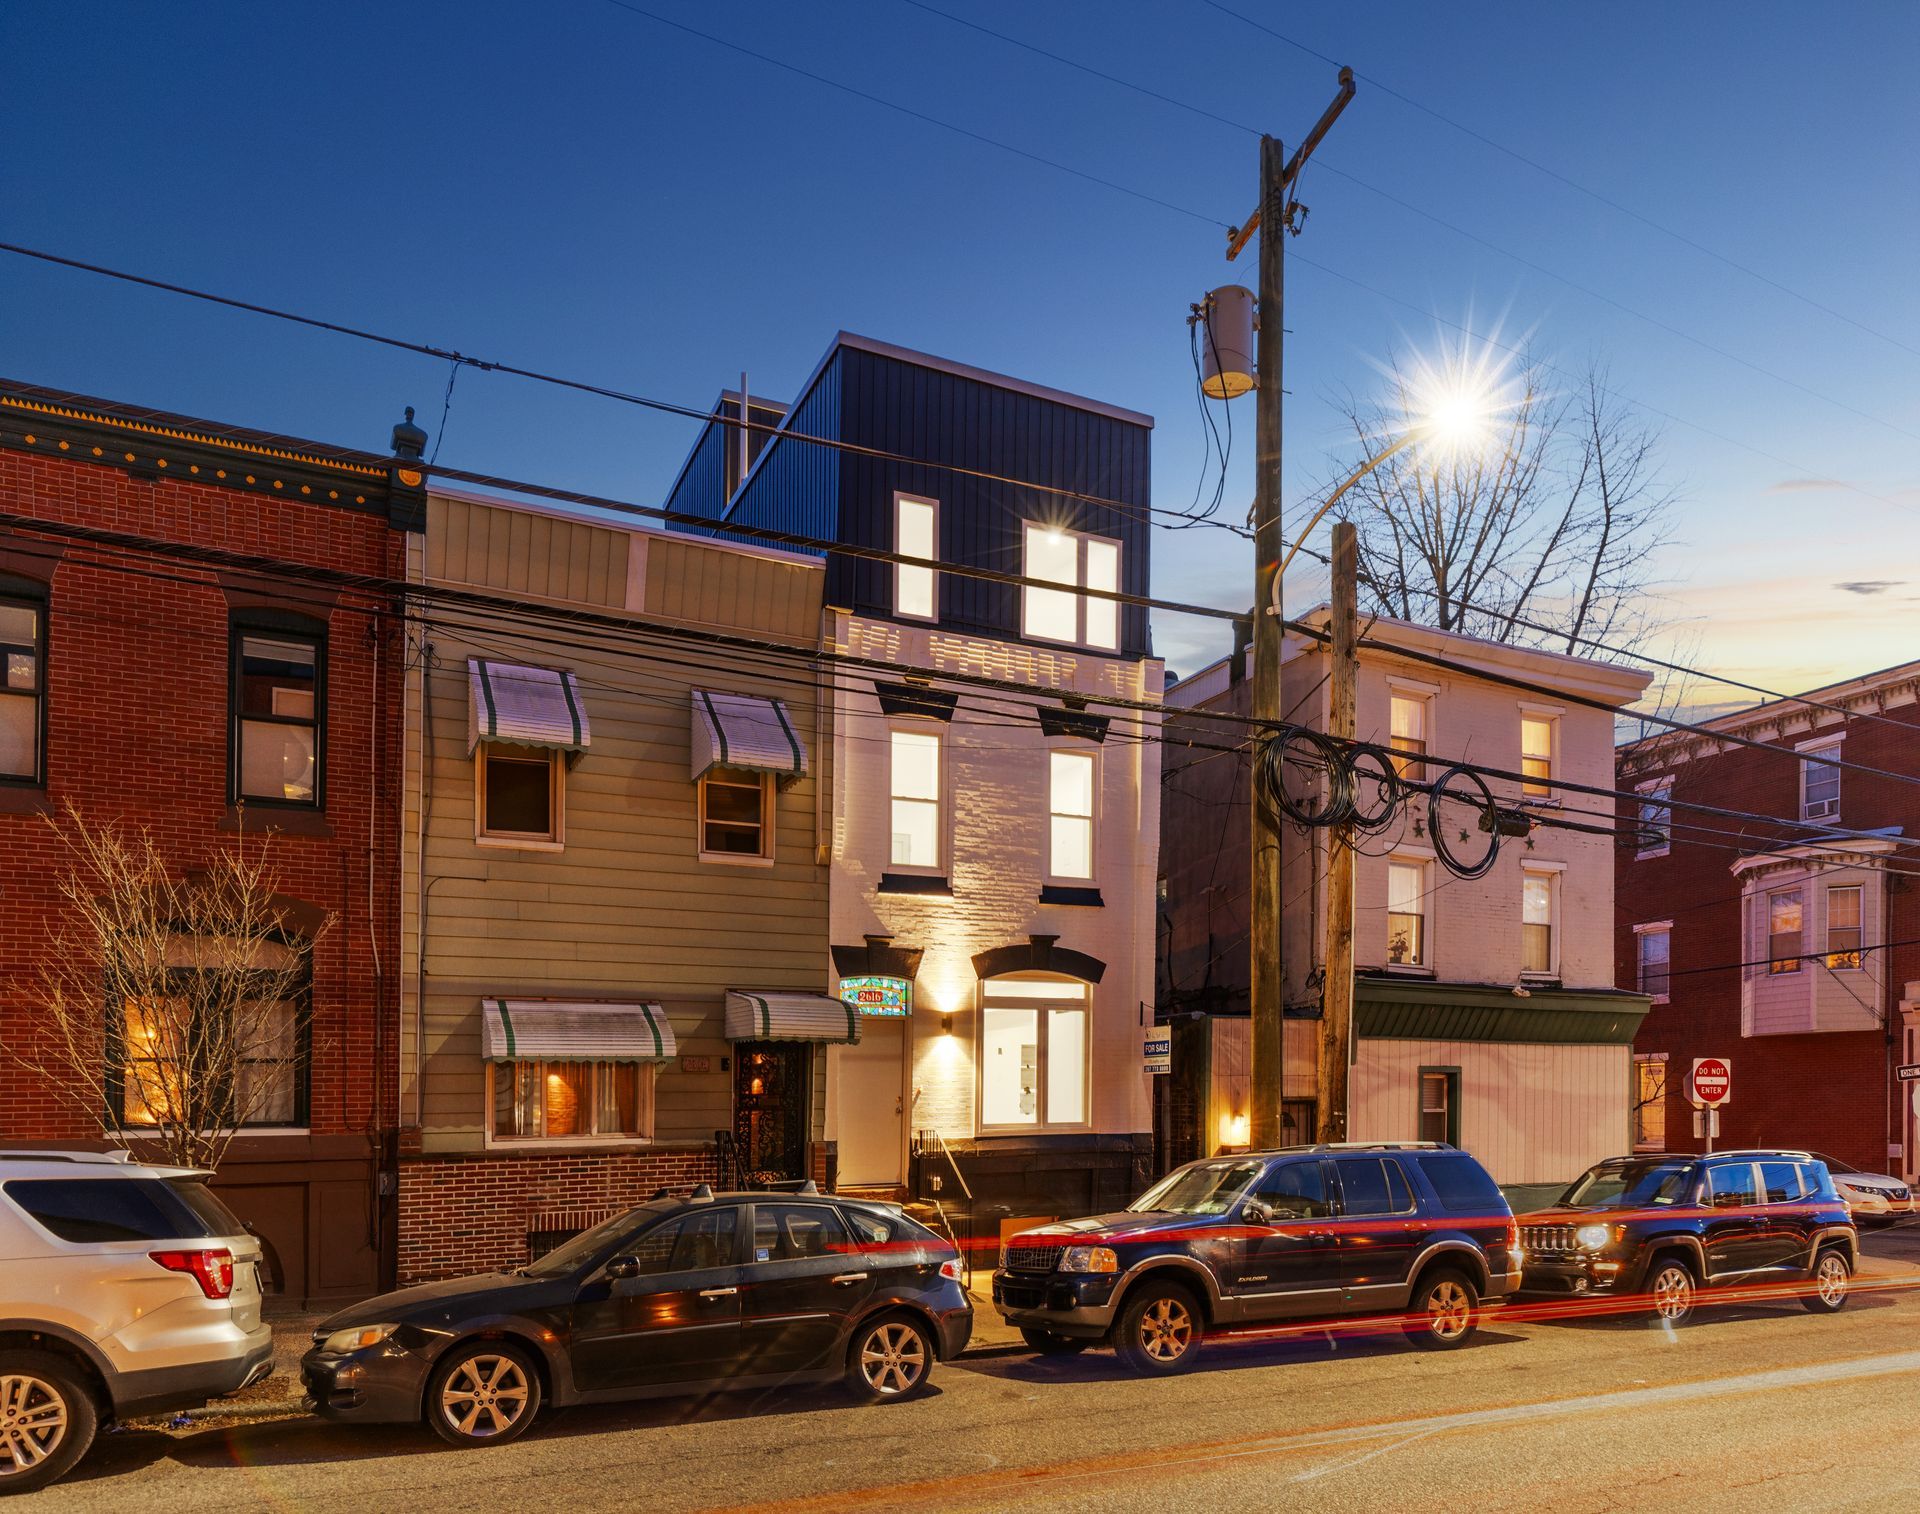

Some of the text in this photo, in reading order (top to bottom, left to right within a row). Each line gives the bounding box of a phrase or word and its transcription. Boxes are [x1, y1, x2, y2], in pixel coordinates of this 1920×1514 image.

[860, 992, 881, 1002] 2616
[1145, 1043, 1168, 1053] FOR SALE
[1698, 1067, 1724, 1075] DO NOT
[1701, 1086, 1722, 1094] ENTER
